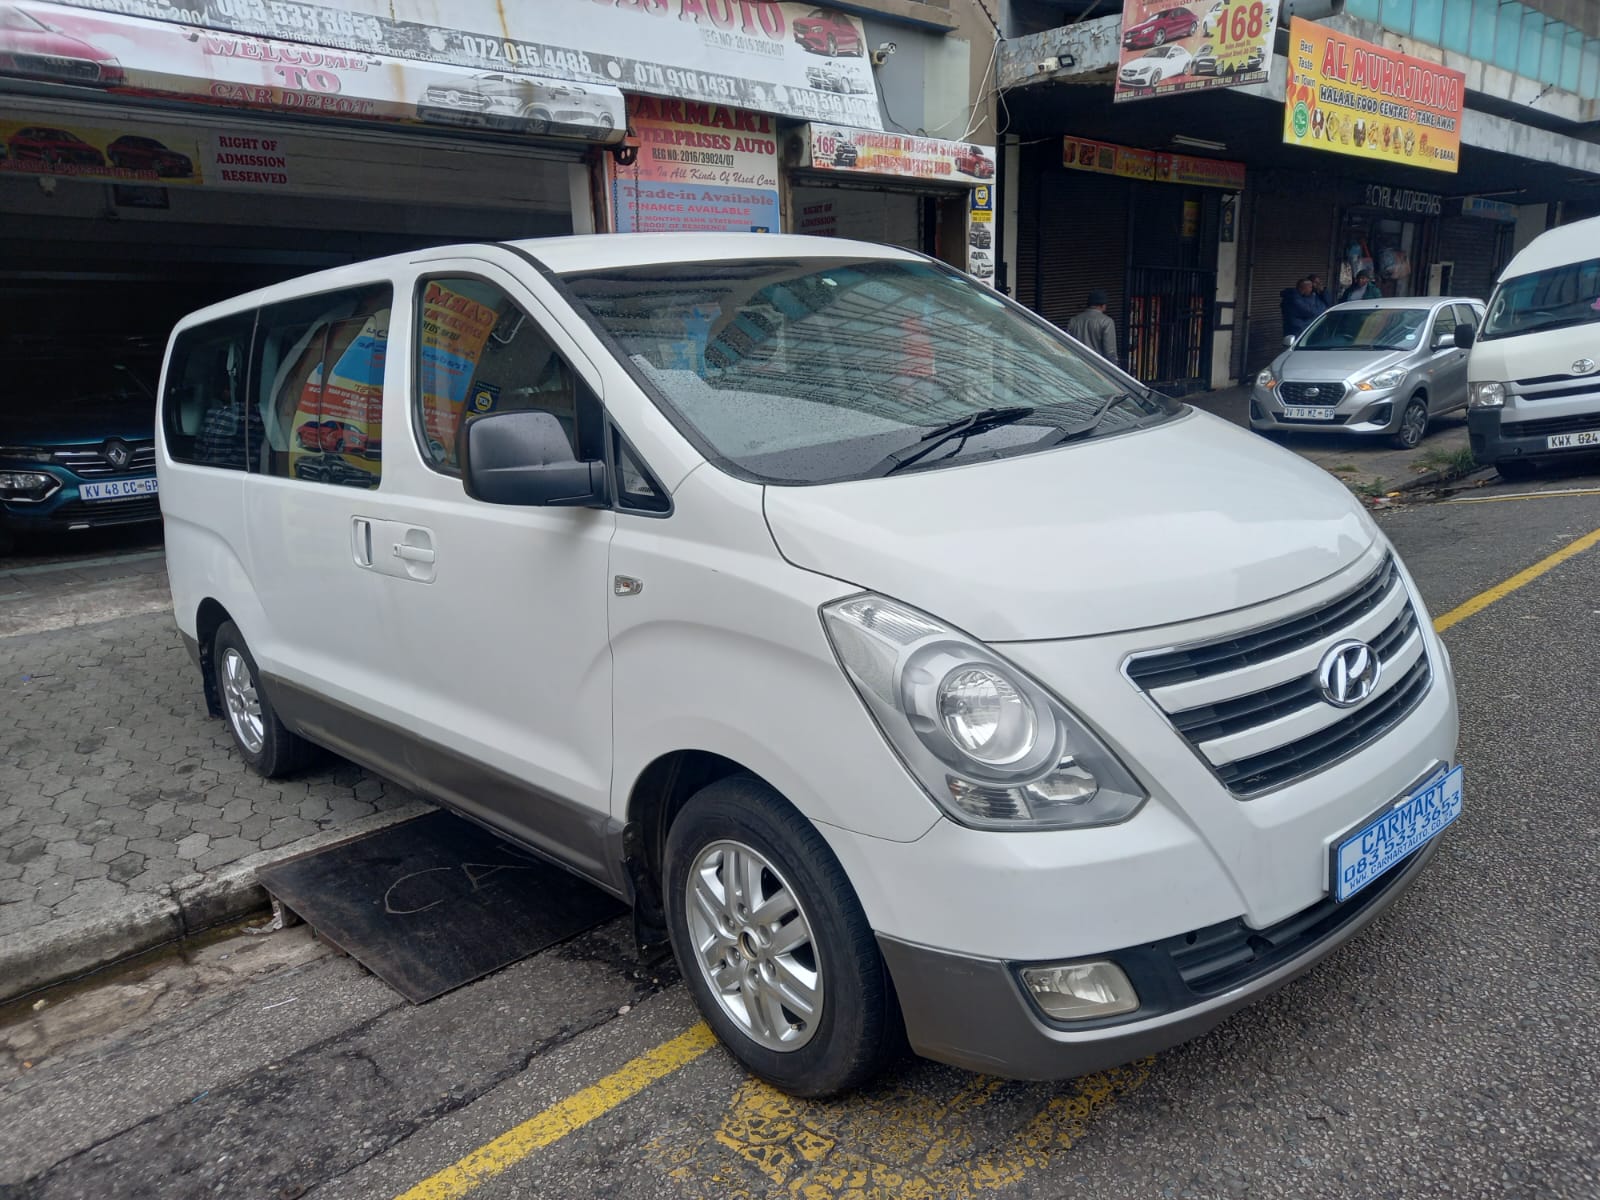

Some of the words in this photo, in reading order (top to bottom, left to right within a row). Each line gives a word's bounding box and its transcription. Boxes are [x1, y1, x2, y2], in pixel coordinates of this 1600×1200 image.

[678, 0, 785, 41] AUTO
[1216, 3, 1263, 45] 168
[206, 38, 369, 72] WELCOME
[463, 36, 500, 60] 072
[504, 42, 540, 67] 015
[544, 49, 592, 74] 4488
[634, 61, 662, 85] 071
[700, 74, 736, 97] 1437
[1320, 38, 1349, 82] AL
[274, 65, 341, 94] TO
[210, 82, 273, 105] CAR
[282, 92, 374, 113] DEPOT
[1319, 84, 1355, 108] HALAAL
[1355, 93, 1378, 114] FOOD
[1379, 102, 1408, 120] CENTRE
[1416, 110, 1436, 126] TAKE
[1436, 116, 1456, 132] AWAY
[632, 95, 771, 134] ARMART
[218, 136, 259, 151] RIGHT
[261, 139, 278, 151] OF
[735, 136, 775, 155] AUTO
[817, 135, 835, 154] 168
[216, 152, 285, 168] ADMISSION
[652, 147, 666, 160] REG
[667, 149, 680, 161] NO:
[681, 149, 734, 166] 2016/39024/07
[222, 169, 287, 185] RESERVED
[658, 166, 668, 177] In
[670, 167, 686, 179] All
[690, 168, 716, 182] Kinds
[720, 171, 730, 185] Of
[733, 172, 755, 185] Used
[757, 174, 776, 187] Cars
[624, 186, 697, 200] Trade-in
[701, 191, 774, 206] Available
[628, 202, 684, 213] FINANCE
[688, 205, 752, 215] AVAILABLE
[1325, 410, 1334, 418] GP
[85, 486, 100, 498] KV
[105, 483, 119, 496] 48
[1361, 781, 1447, 855] CARMART
[1344, 847, 1379, 884] 083
[1384, 822, 1417, 855] 533
[1421, 791, 1460, 829] 3653
